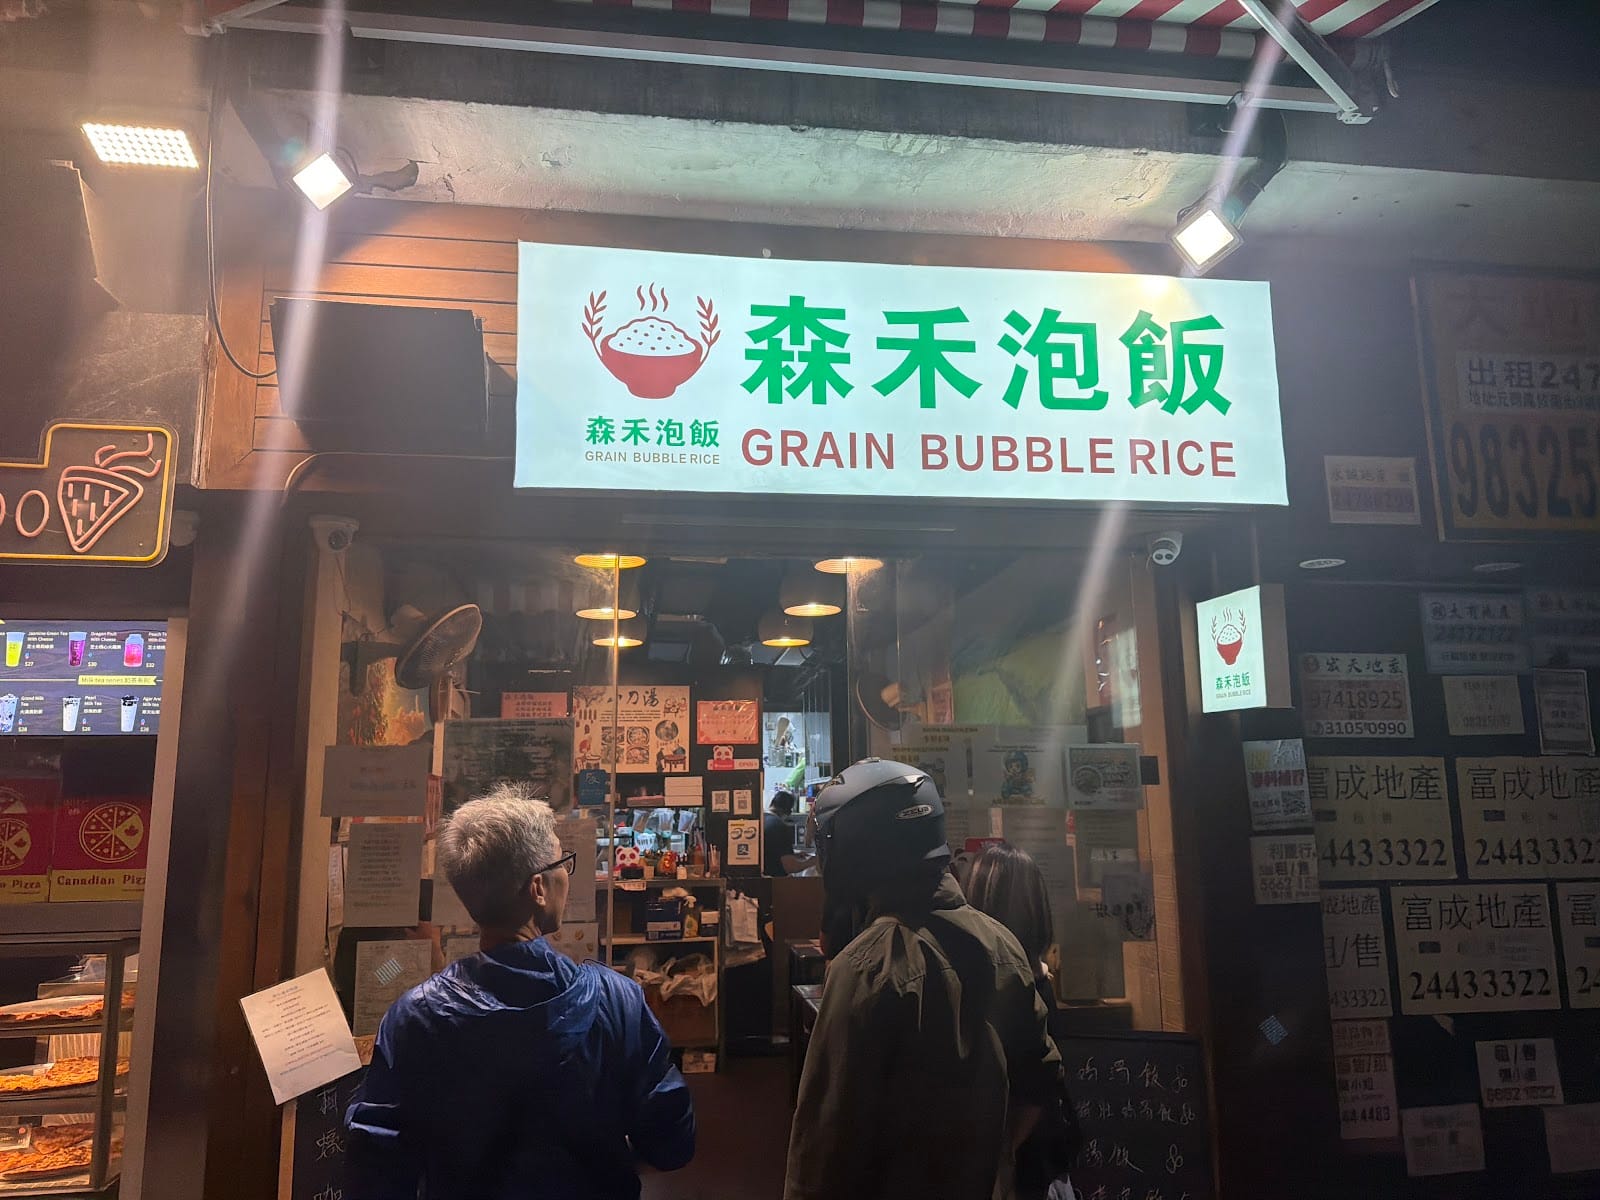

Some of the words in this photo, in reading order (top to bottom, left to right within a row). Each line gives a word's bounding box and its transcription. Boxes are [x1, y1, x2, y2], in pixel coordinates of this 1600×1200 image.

[740, 295, 1232, 416] 森禾泡飯
[585, 416, 720, 448] 森禾泡飯
[585, 451, 627, 462] GRAIN
[633, 452, 687, 464] BUBBLE
[690, 453, 720, 465] RICE
[741, 428, 895, 470] GRAIN
[921, 434, 1115, 474] BUBBLE
[1129, 438, 1236, 478] RICE
[1467, 764, 1600, 801] 富成地產
[1475, 838, 1600, 866] 2443332
[12, 880, 41, 889] Pizza
[57, 875, 115, 886] Canadian
[1400, 893, 1547, 931] 富成地產
[1410, 968, 1550, 1000] 24433322
